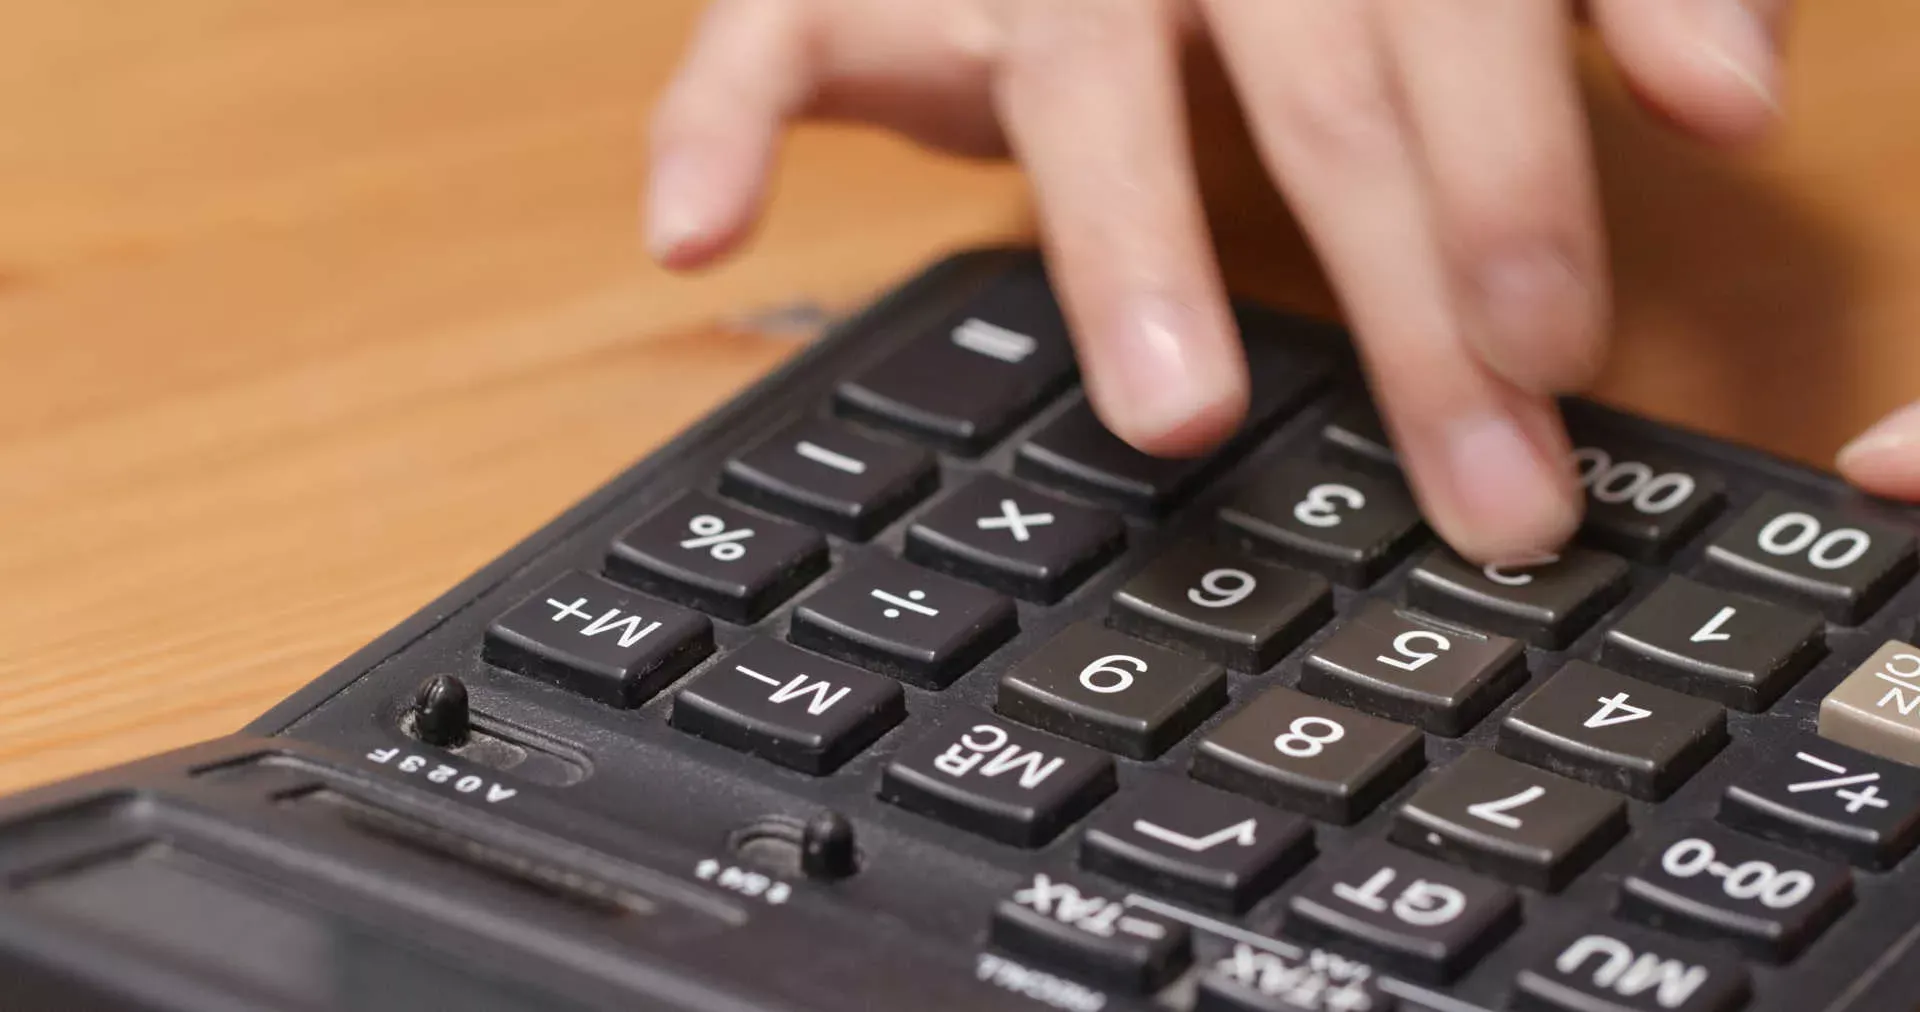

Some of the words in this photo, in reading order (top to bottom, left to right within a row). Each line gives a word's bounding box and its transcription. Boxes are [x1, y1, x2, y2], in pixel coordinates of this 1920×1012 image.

[1294, 484, 1365, 527] 3
[1757, 512, 1871, 569] 00
[1188, 569, 1256, 607] 6
[546, 597, 662, 648] M+
[1690, 606, 1736, 642] 1
[1376, 631, 1451, 671] 5
[1079, 655, 1148, 693] 9
[1583, 692, 1652, 728] 4
[1273, 716, 1346, 758] 8
[366, 748, 517, 803] A023F
[1467, 785, 1546, 829] 7
[1662, 838, 1815, 908] 00-0
[1333, 867, 1467, 926] GT
[1556, 935, 1707, 1008] MU
